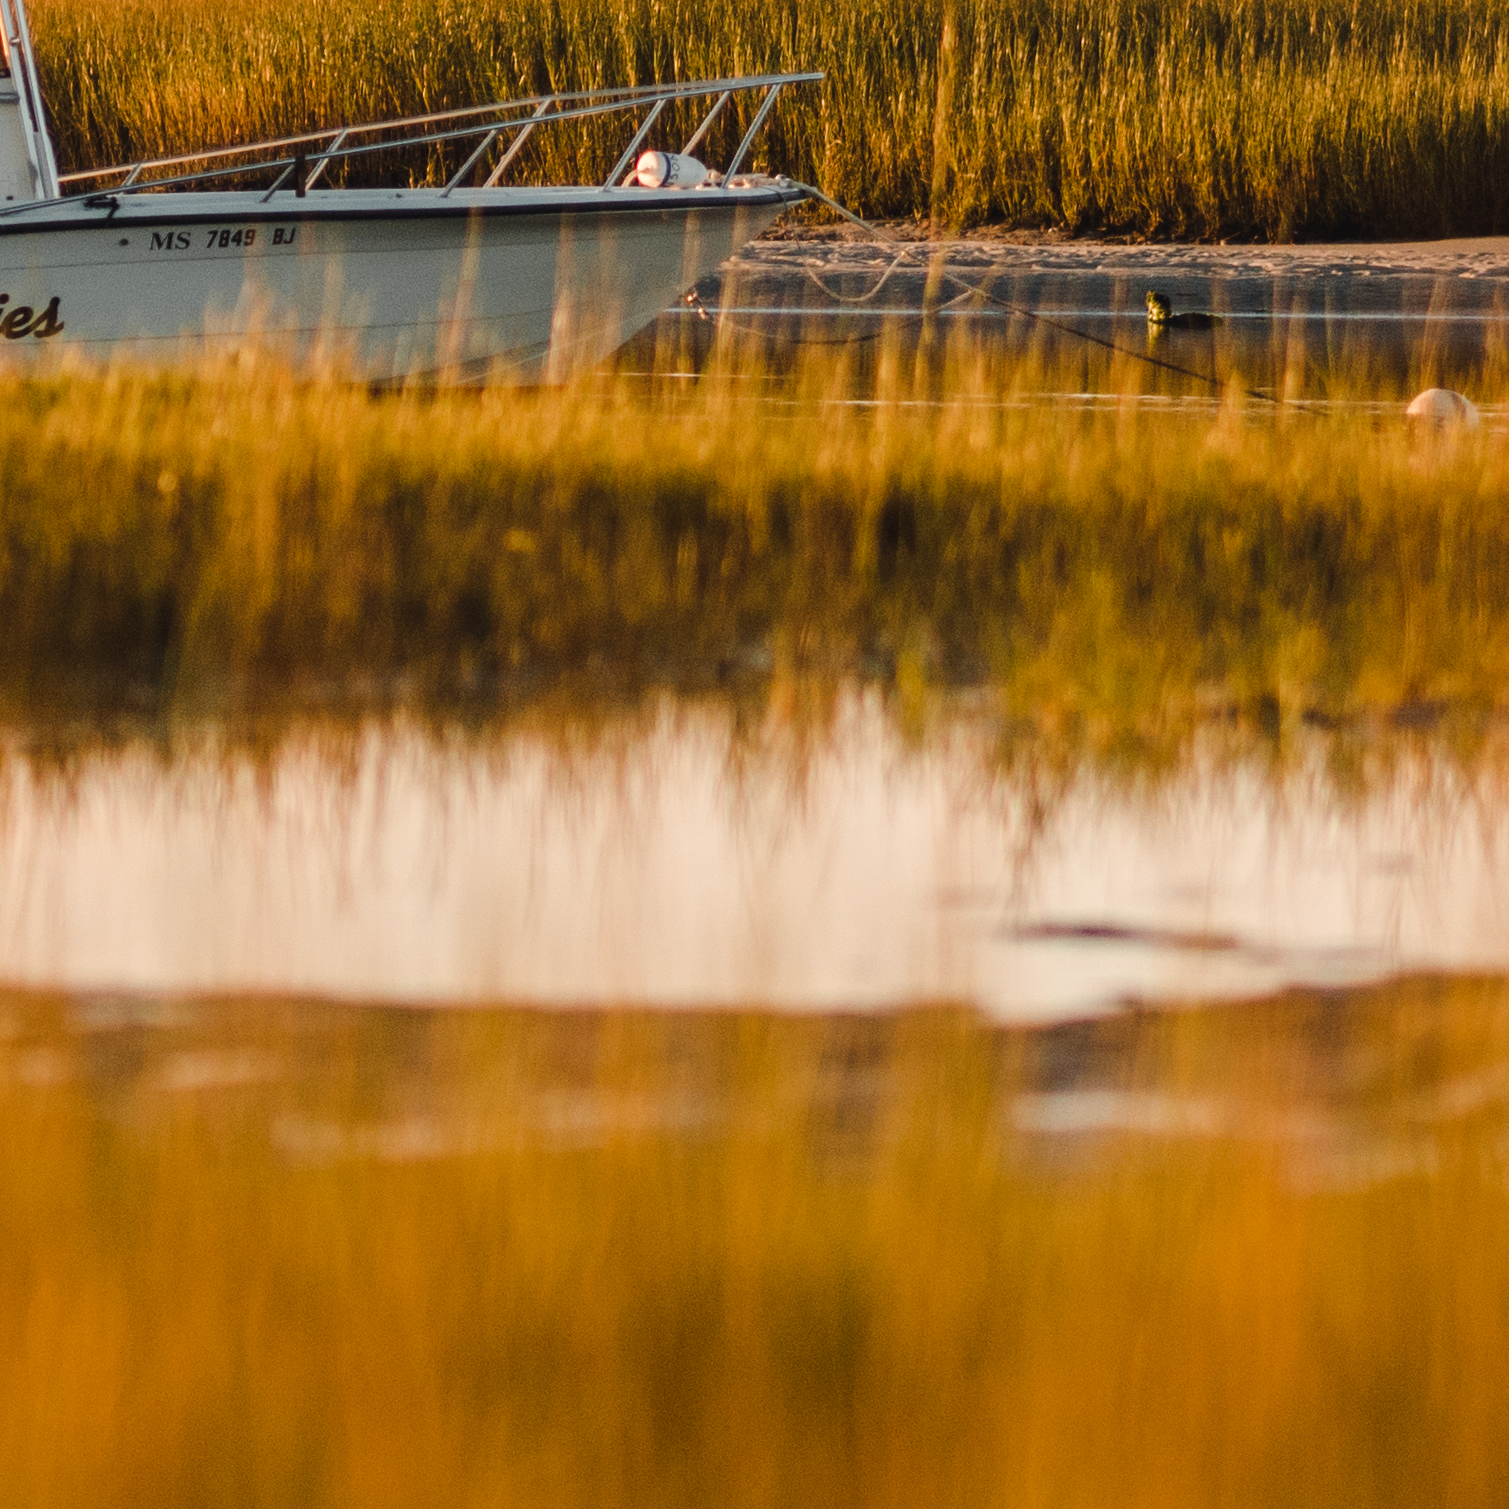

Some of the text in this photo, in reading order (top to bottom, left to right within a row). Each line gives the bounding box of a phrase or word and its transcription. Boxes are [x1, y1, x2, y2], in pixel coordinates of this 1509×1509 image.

[149, 227, 297, 251] MS 7849 BJ
